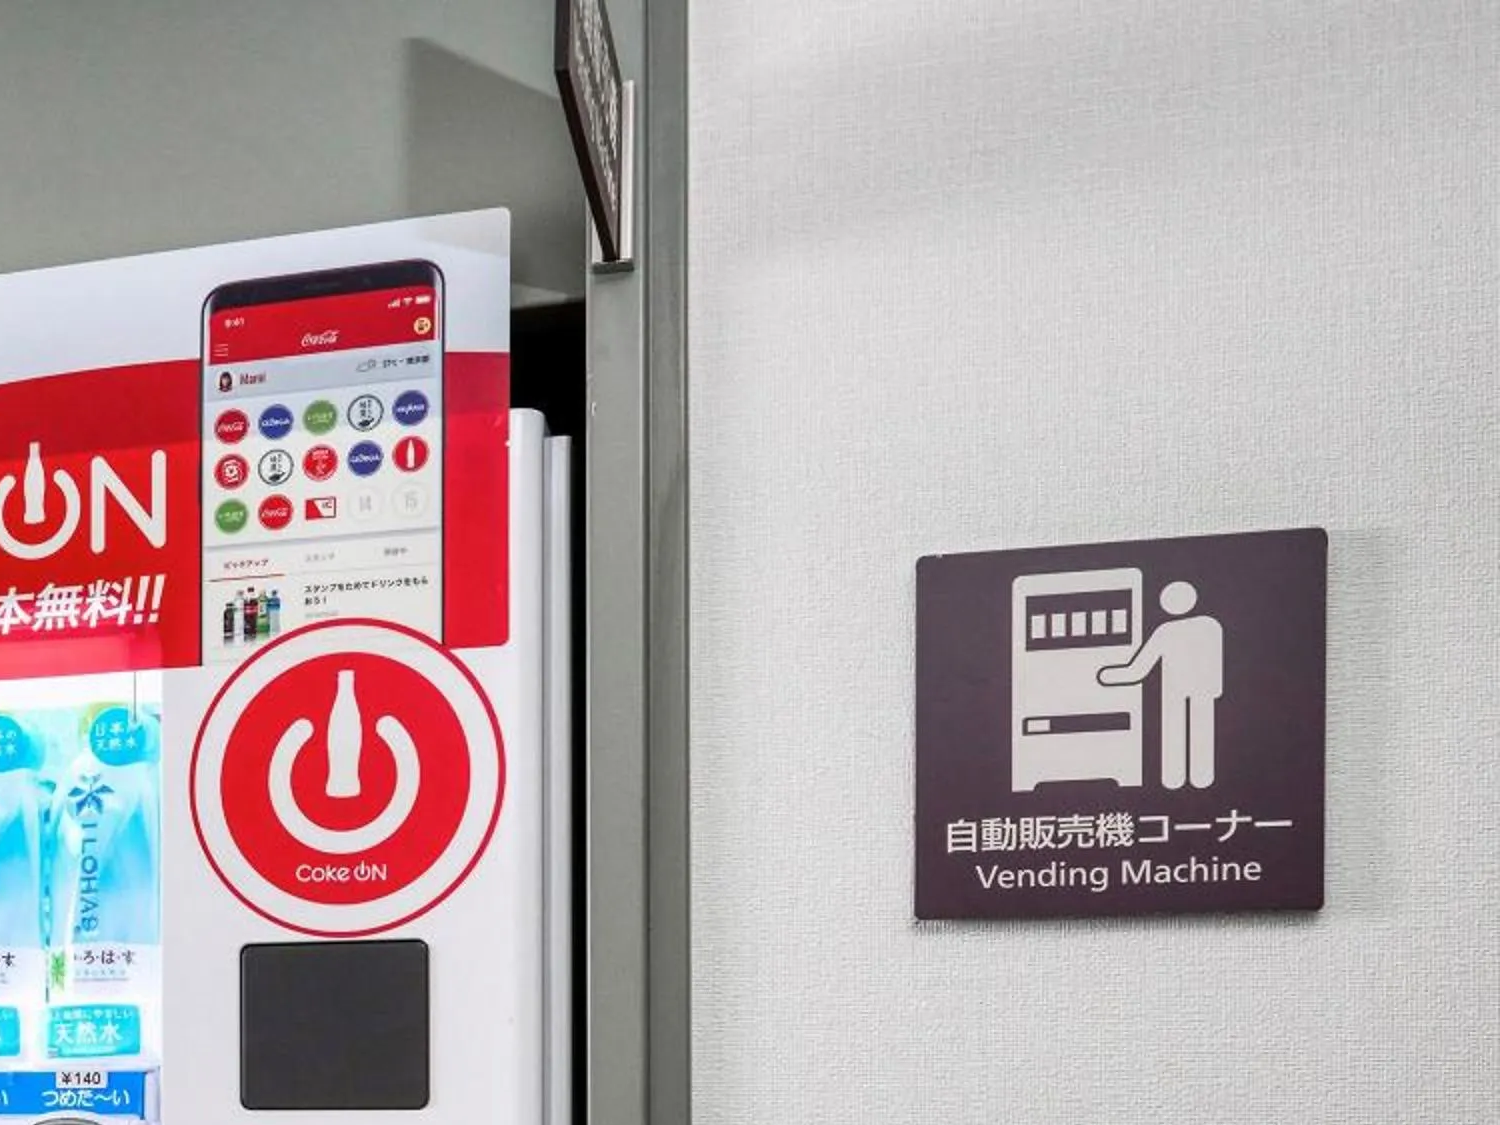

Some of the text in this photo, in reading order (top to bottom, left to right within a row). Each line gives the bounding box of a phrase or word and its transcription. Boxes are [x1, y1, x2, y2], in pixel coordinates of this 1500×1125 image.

[946, 810, 1293, 854] 自動販売機コーナー
[296, 860, 388, 882] Coke ON
[974, 855, 1263, 892] Vending Machine
[60, 1072, 101, 1086] ¥140
